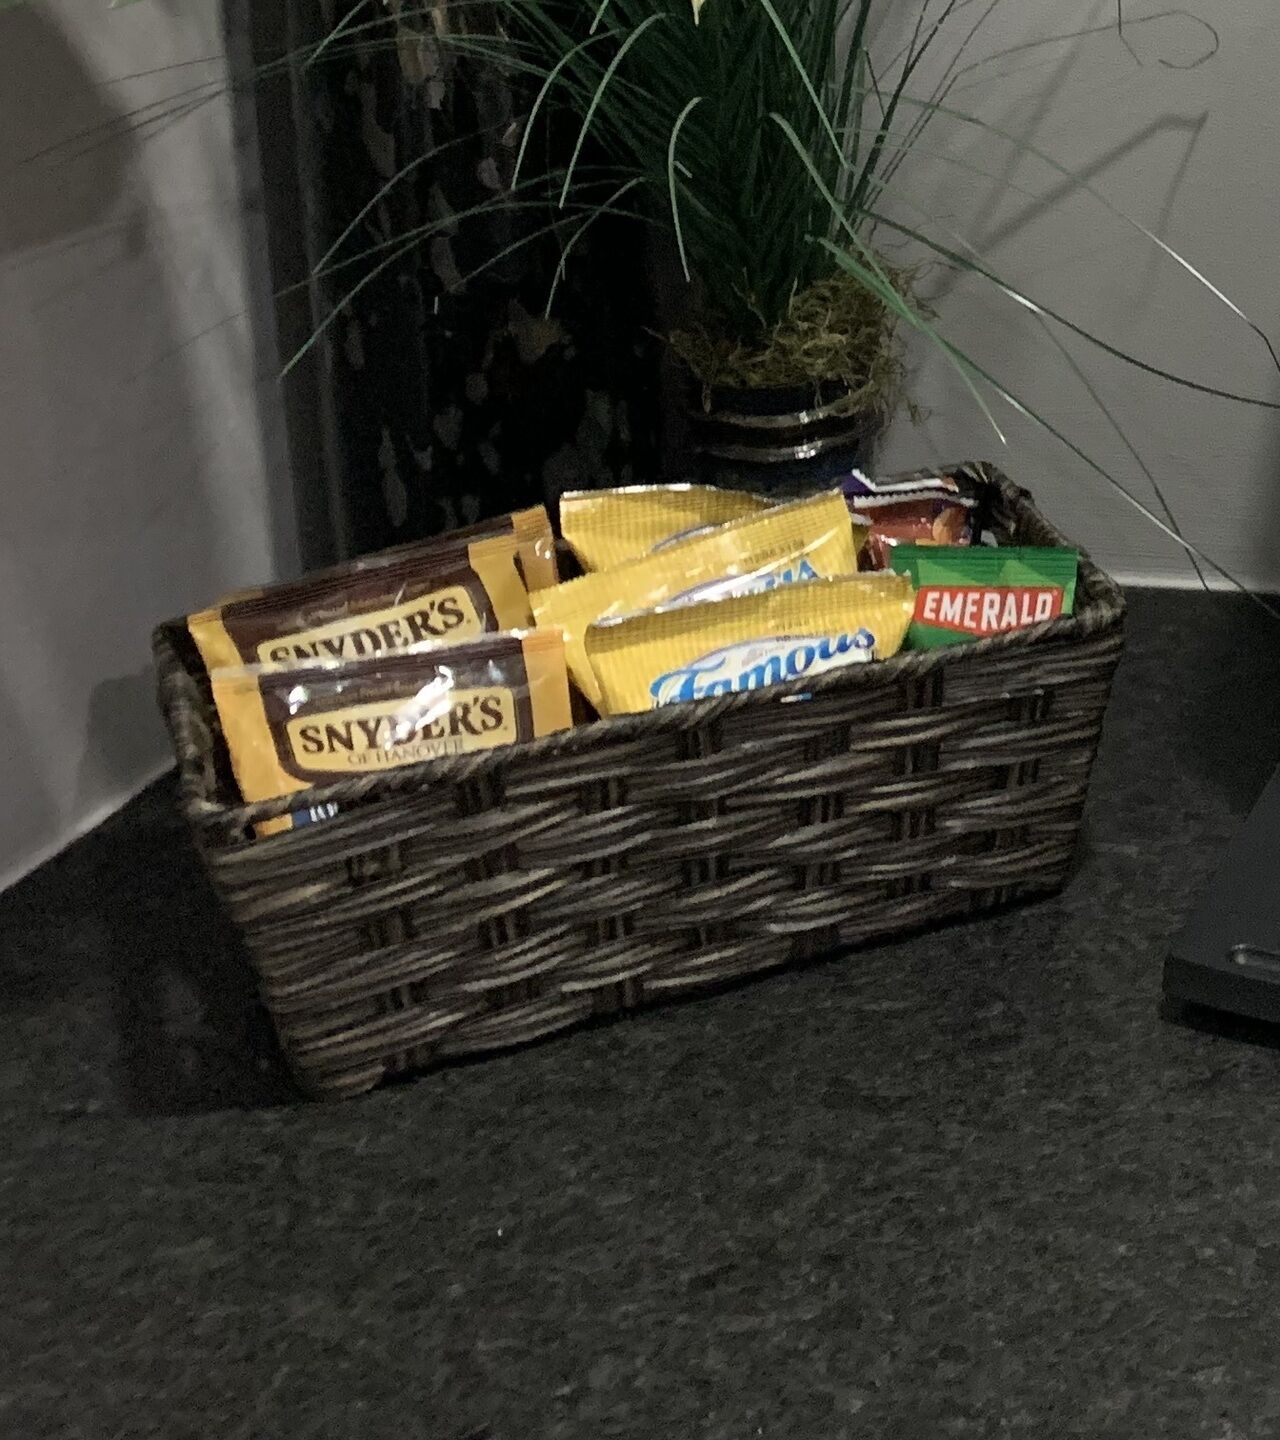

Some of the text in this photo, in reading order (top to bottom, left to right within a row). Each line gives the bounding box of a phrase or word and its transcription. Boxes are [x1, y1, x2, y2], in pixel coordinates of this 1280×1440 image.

[923, 591, 1053, 632] EMERALD
[650, 627, 876, 702] Famous
[375, 739, 464, 764] HANOVER
